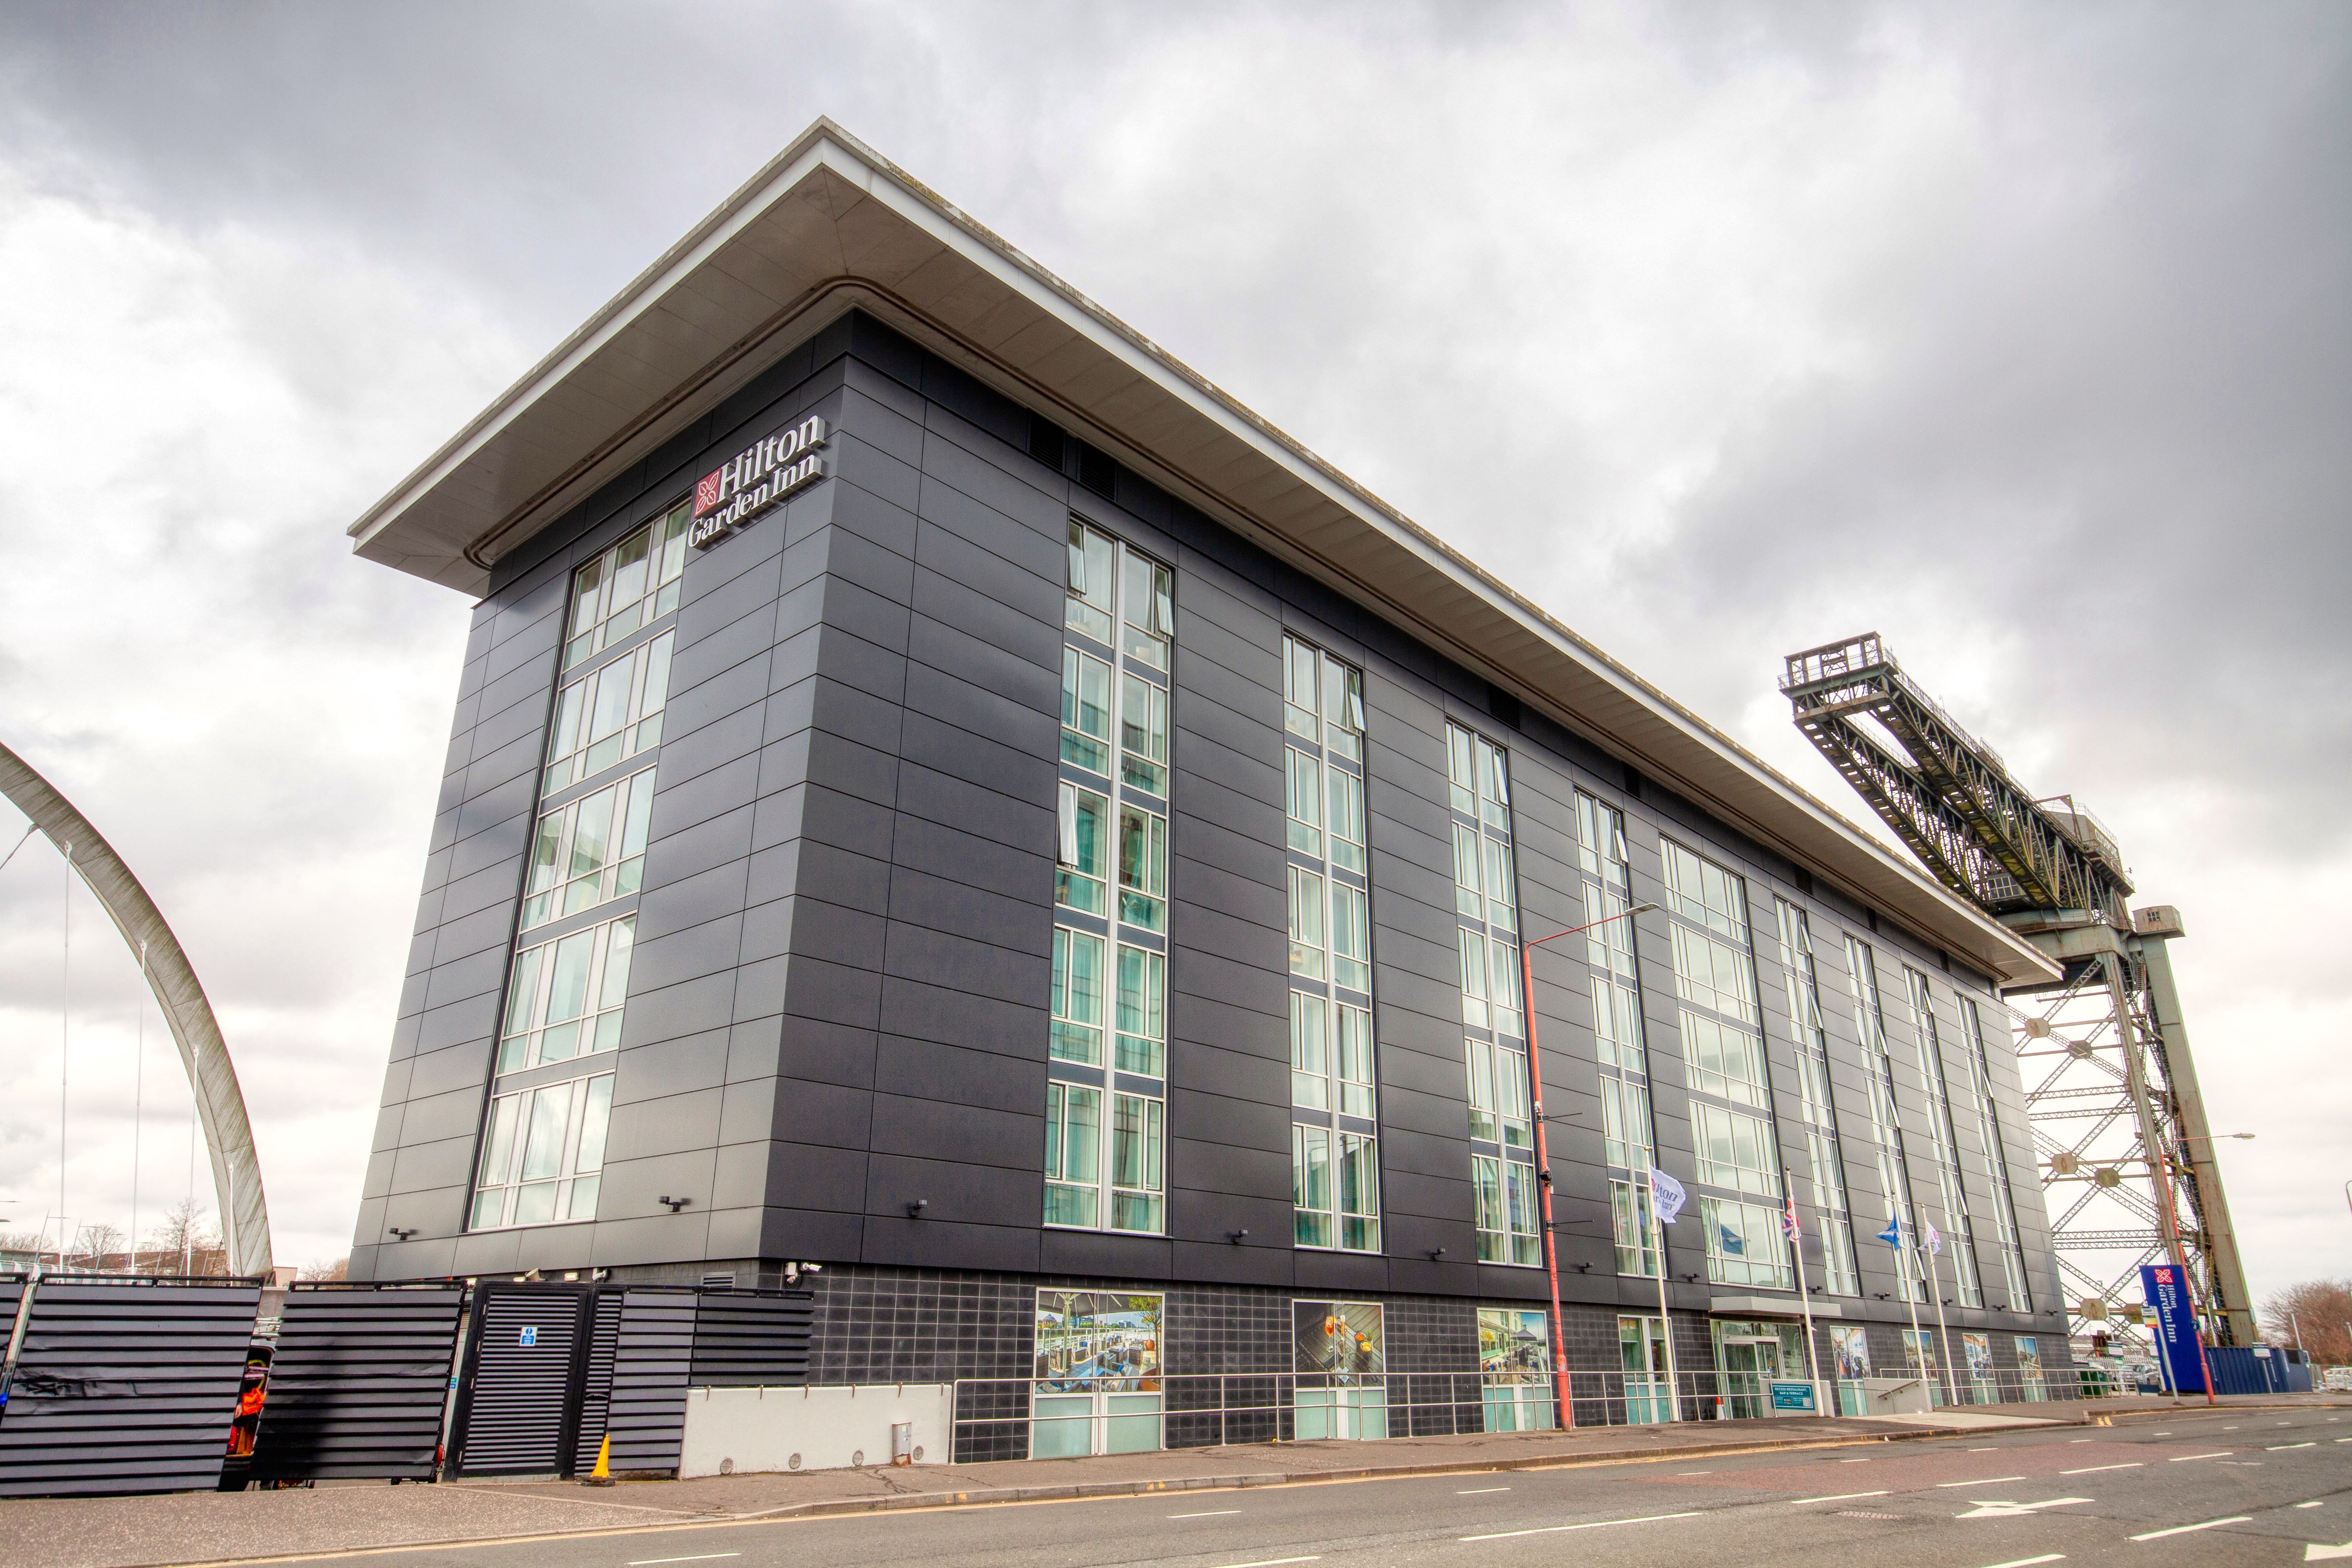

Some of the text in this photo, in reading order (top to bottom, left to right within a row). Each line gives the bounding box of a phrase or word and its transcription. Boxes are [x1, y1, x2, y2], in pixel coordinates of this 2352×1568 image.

[717, 415, 822, 503] Hilton
[688, 454, 820, 548] Garden Inn
[2157, 1284, 2177, 1343] Garden Inn
[2166, 1284, 2177, 1308] Hilton
